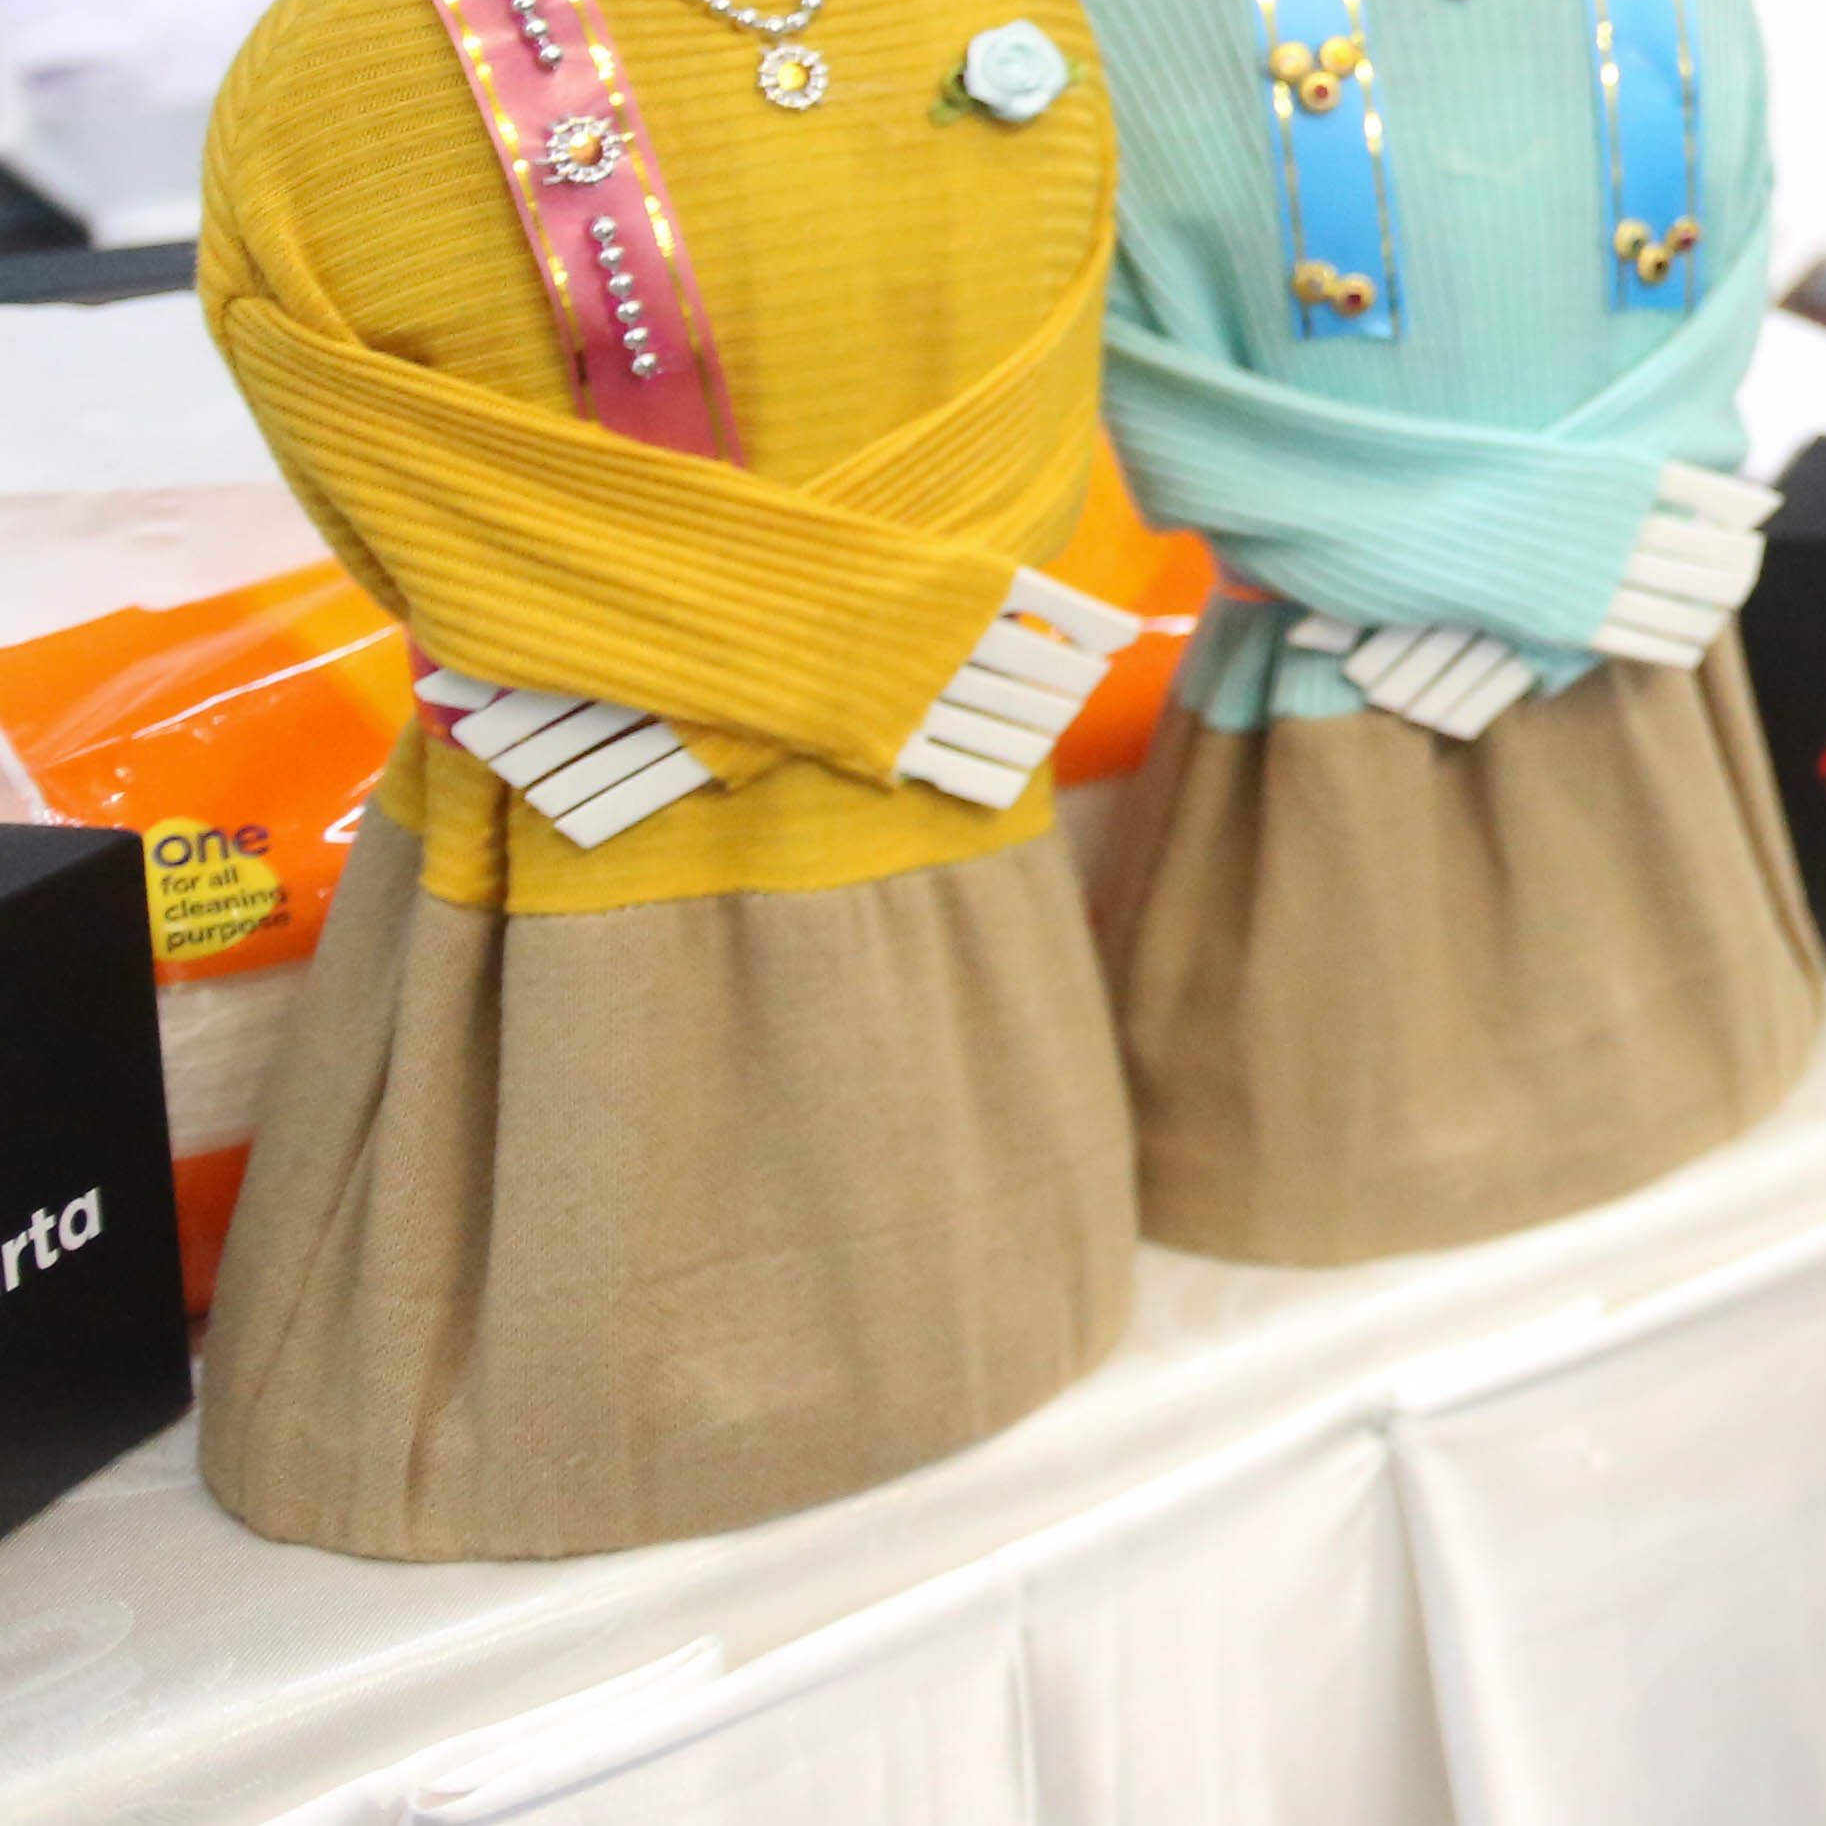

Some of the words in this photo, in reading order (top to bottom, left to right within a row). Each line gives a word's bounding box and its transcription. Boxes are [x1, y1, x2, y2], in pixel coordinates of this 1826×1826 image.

[154, 825, 269, 868] one
[161, 876, 199, 896] for
[209, 867, 238, 886] all
[164, 884, 288, 922] cleaning
[167, 910, 291, 952] purpose
